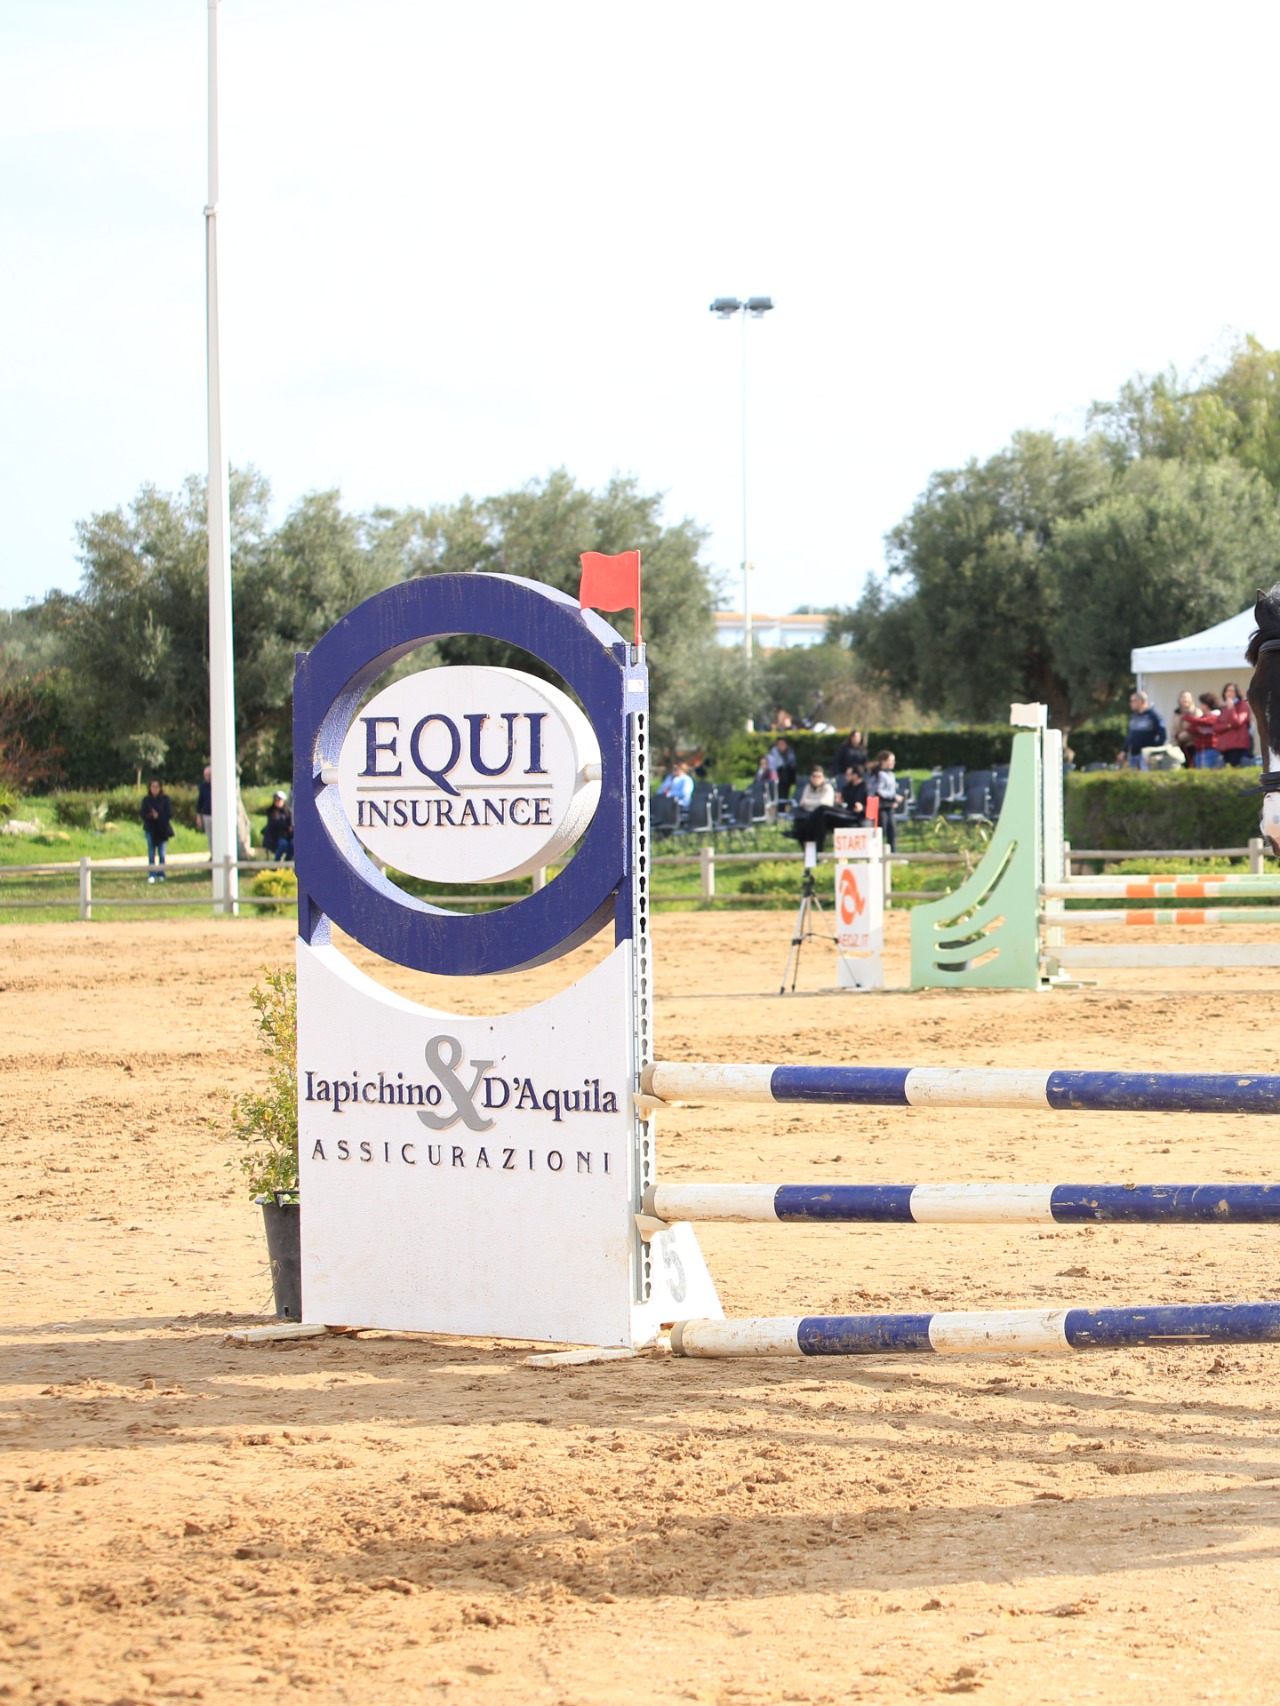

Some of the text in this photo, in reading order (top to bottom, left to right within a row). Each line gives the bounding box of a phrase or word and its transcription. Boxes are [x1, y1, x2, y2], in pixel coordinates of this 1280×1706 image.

[357, 712, 549, 797] EQUI
[356, 797, 553, 828] INSURANCE
[836, 835, 867, 851] START
[305, 1070, 442, 1113] Iapichino
[416, 1034, 495, 1132] &
[311, 1139, 611, 1173] ASSICURAZIONI
[659, 1229, 687, 1303] 5
